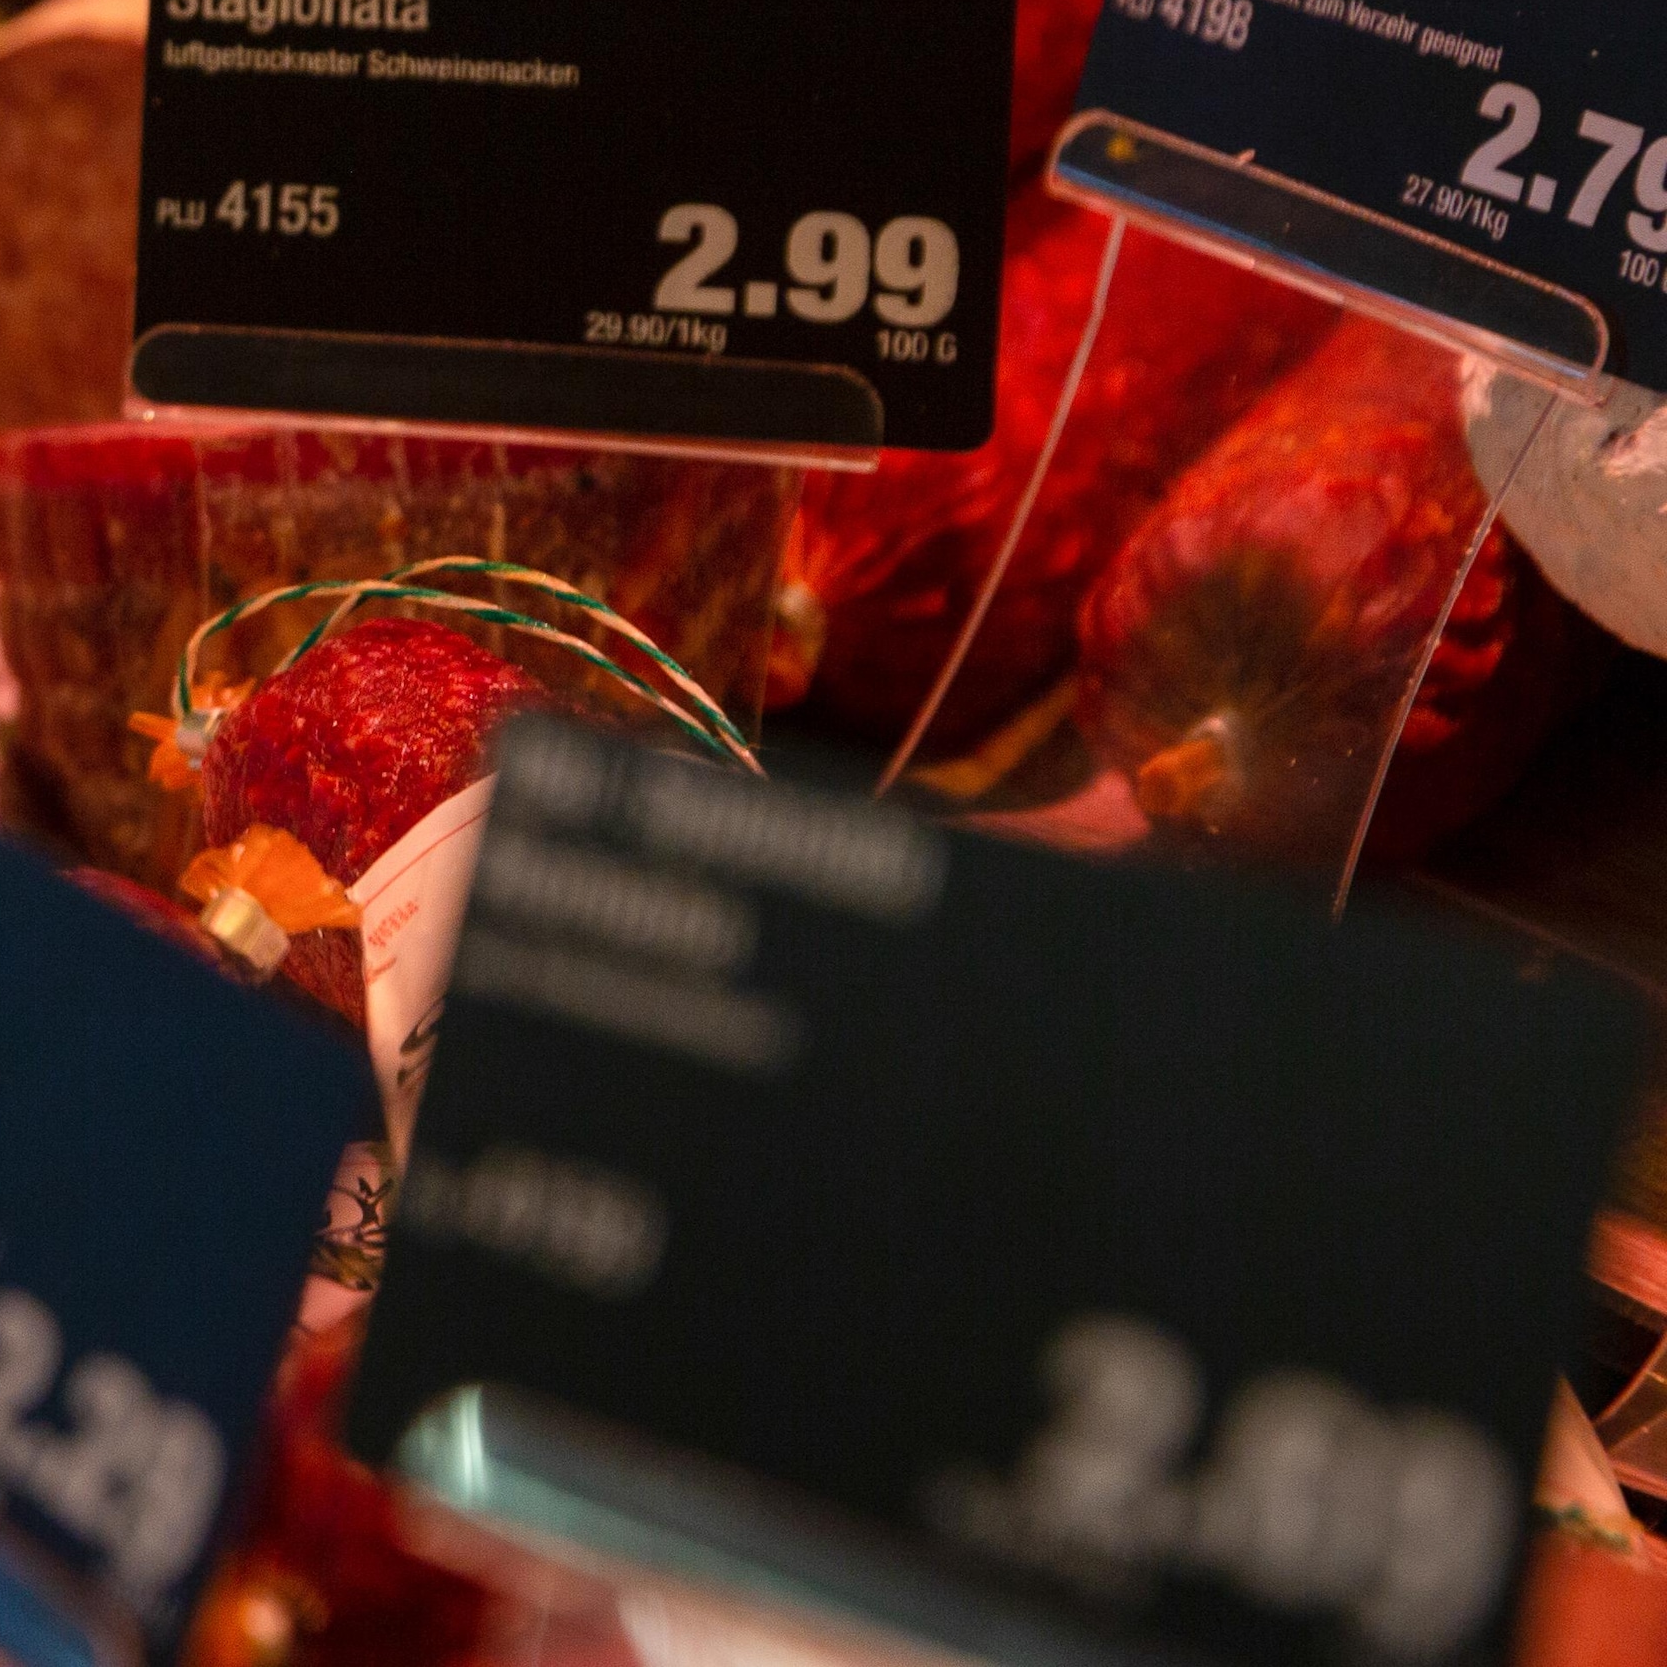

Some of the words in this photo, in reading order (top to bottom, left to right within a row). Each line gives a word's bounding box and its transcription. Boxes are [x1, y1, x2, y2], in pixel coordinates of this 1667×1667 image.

[163, 38, 361, 80] luftgetrockneter
[367, 48, 581, 89] Schweinenacken
[1417, 18, 1505, 72] geeignet
[155, 195, 206, 230] PLU
[215, 180, 341, 239] 4155
[1400, 172, 1511, 242] 27.90/1kg
[1617, 249, 1660, 288] 100
[653, 202, 961, 327] 2.99
[584, 309, 729, 356] 29.90/1kg
[876, 328, 927, 362] 100
[932, 332, 957, 364] G
